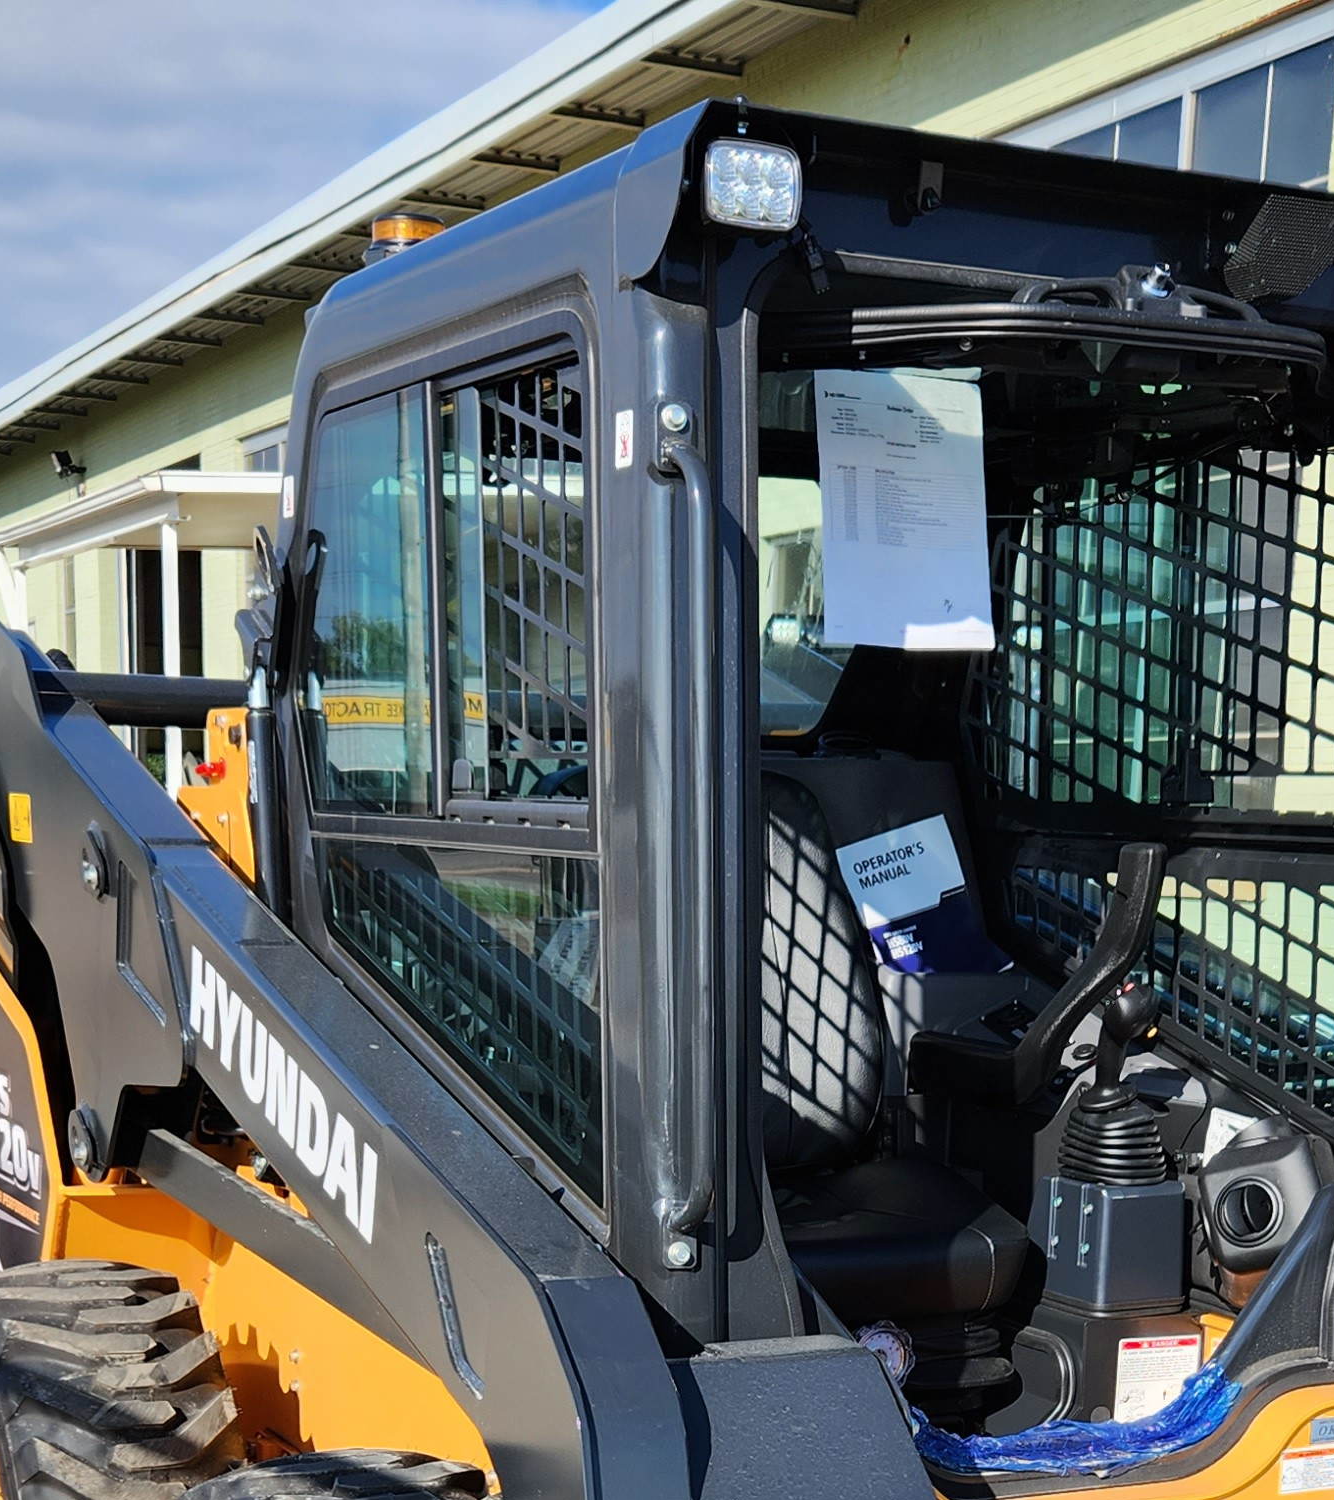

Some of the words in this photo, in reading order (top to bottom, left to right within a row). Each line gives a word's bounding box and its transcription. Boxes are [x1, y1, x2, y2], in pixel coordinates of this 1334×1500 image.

[853, 842, 925, 875] OPERATOR'S
[858, 863, 911, 890] MANUAL
[189, 945, 378, 1244] HYUNDAI
